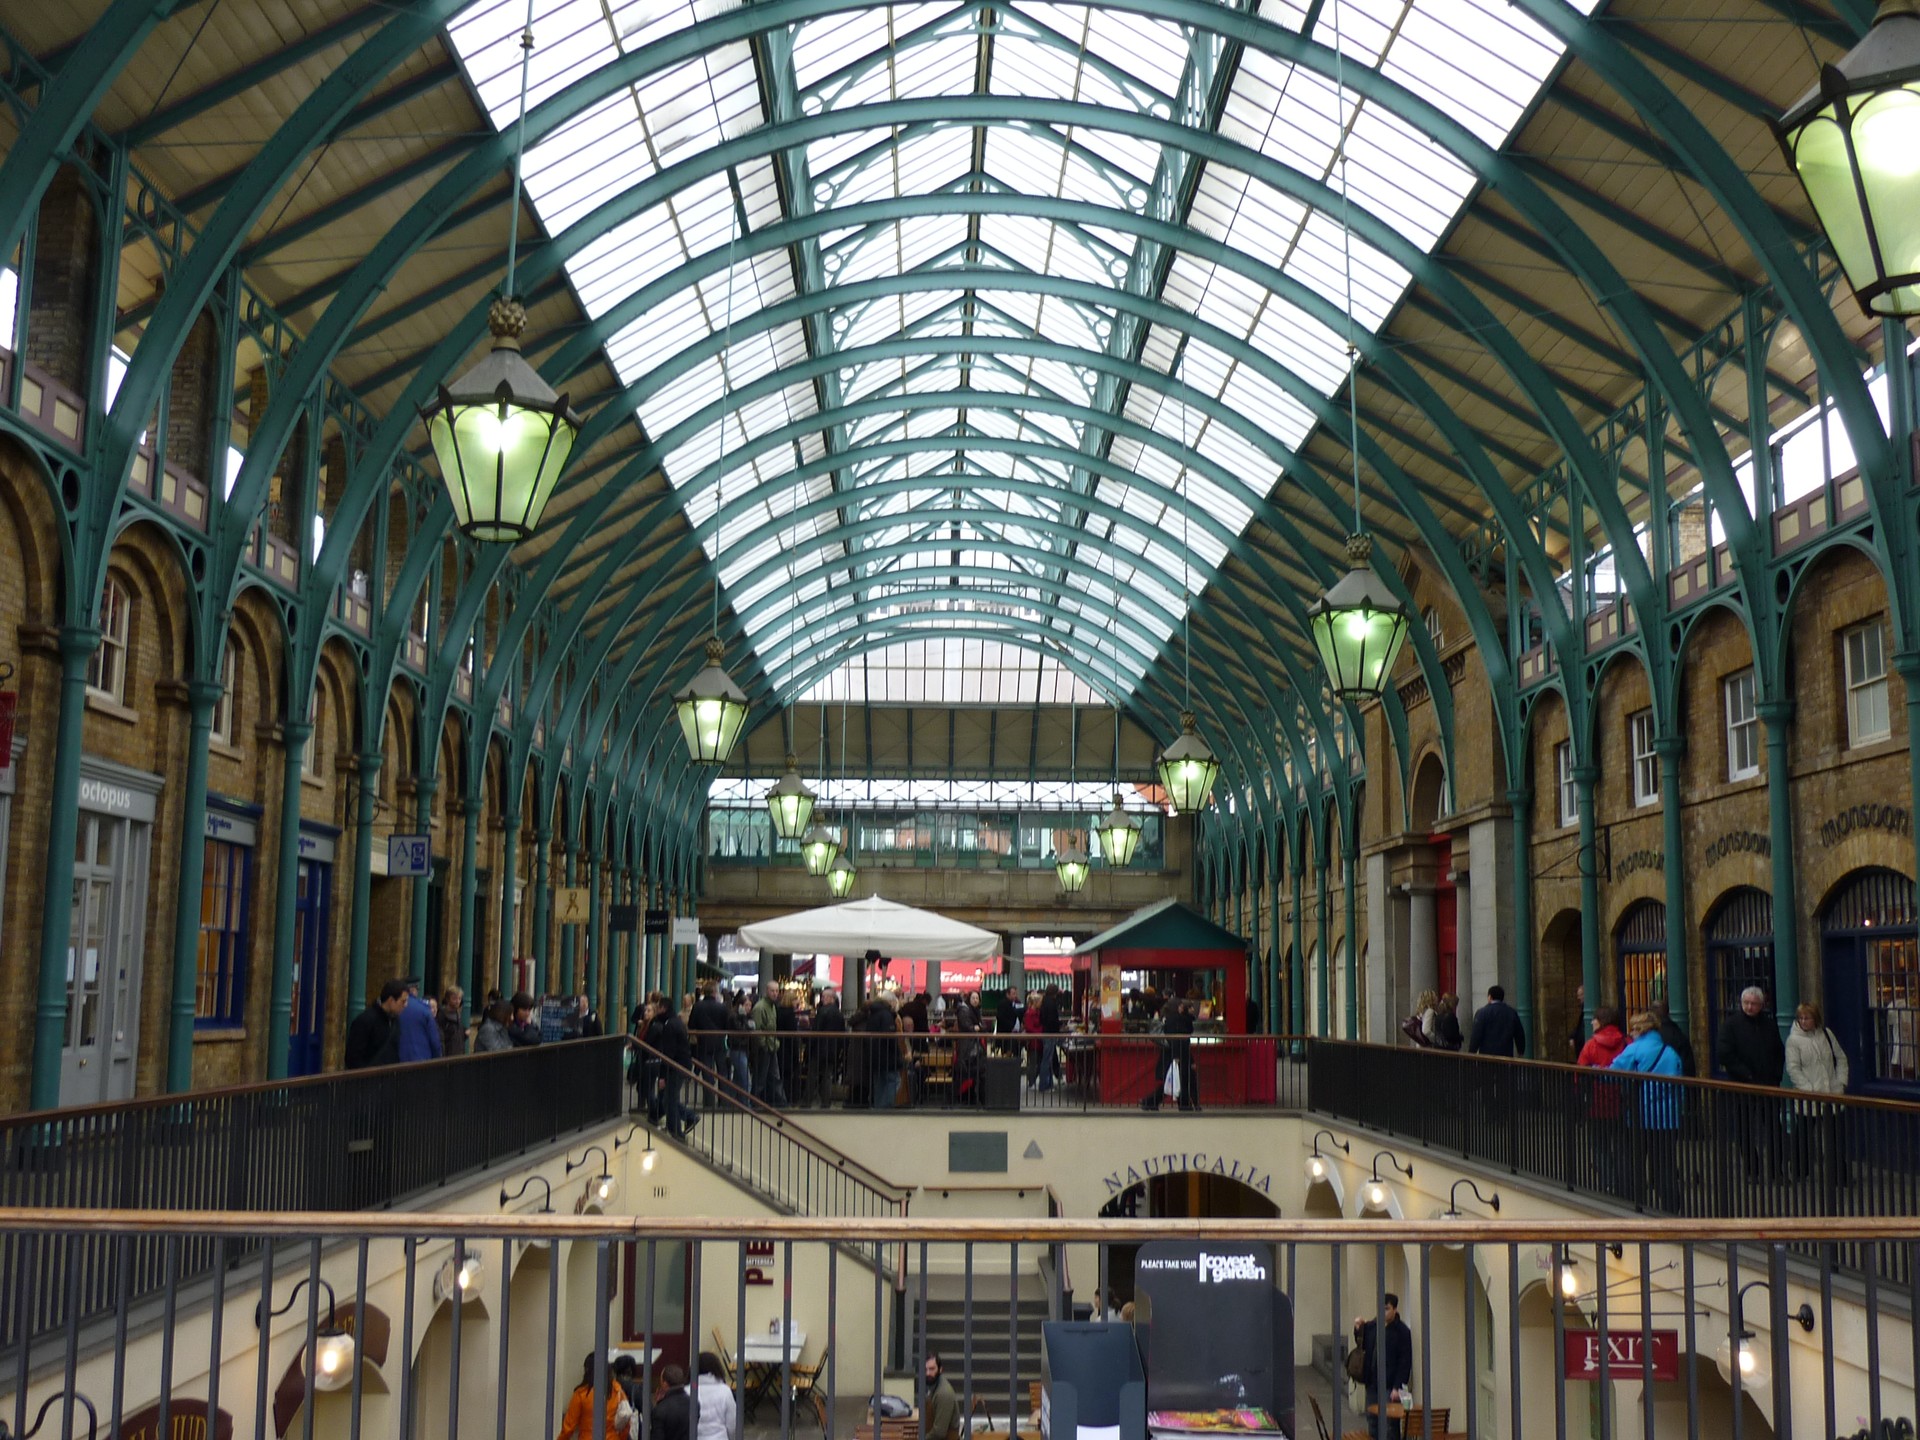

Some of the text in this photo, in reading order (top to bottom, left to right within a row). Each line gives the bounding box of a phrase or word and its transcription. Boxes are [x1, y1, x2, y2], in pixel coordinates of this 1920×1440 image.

[1821, 803, 1909, 848] monsoon
[1102, 1152, 1272, 1195] NAUTICALIA
[1164, 1259, 1180, 1269] TAKE
[1180, 1259, 1197, 1269] YOUR
[1206, 1254, 1256, 1269] covent
[1212, 1265, 1266, 1284] garden
